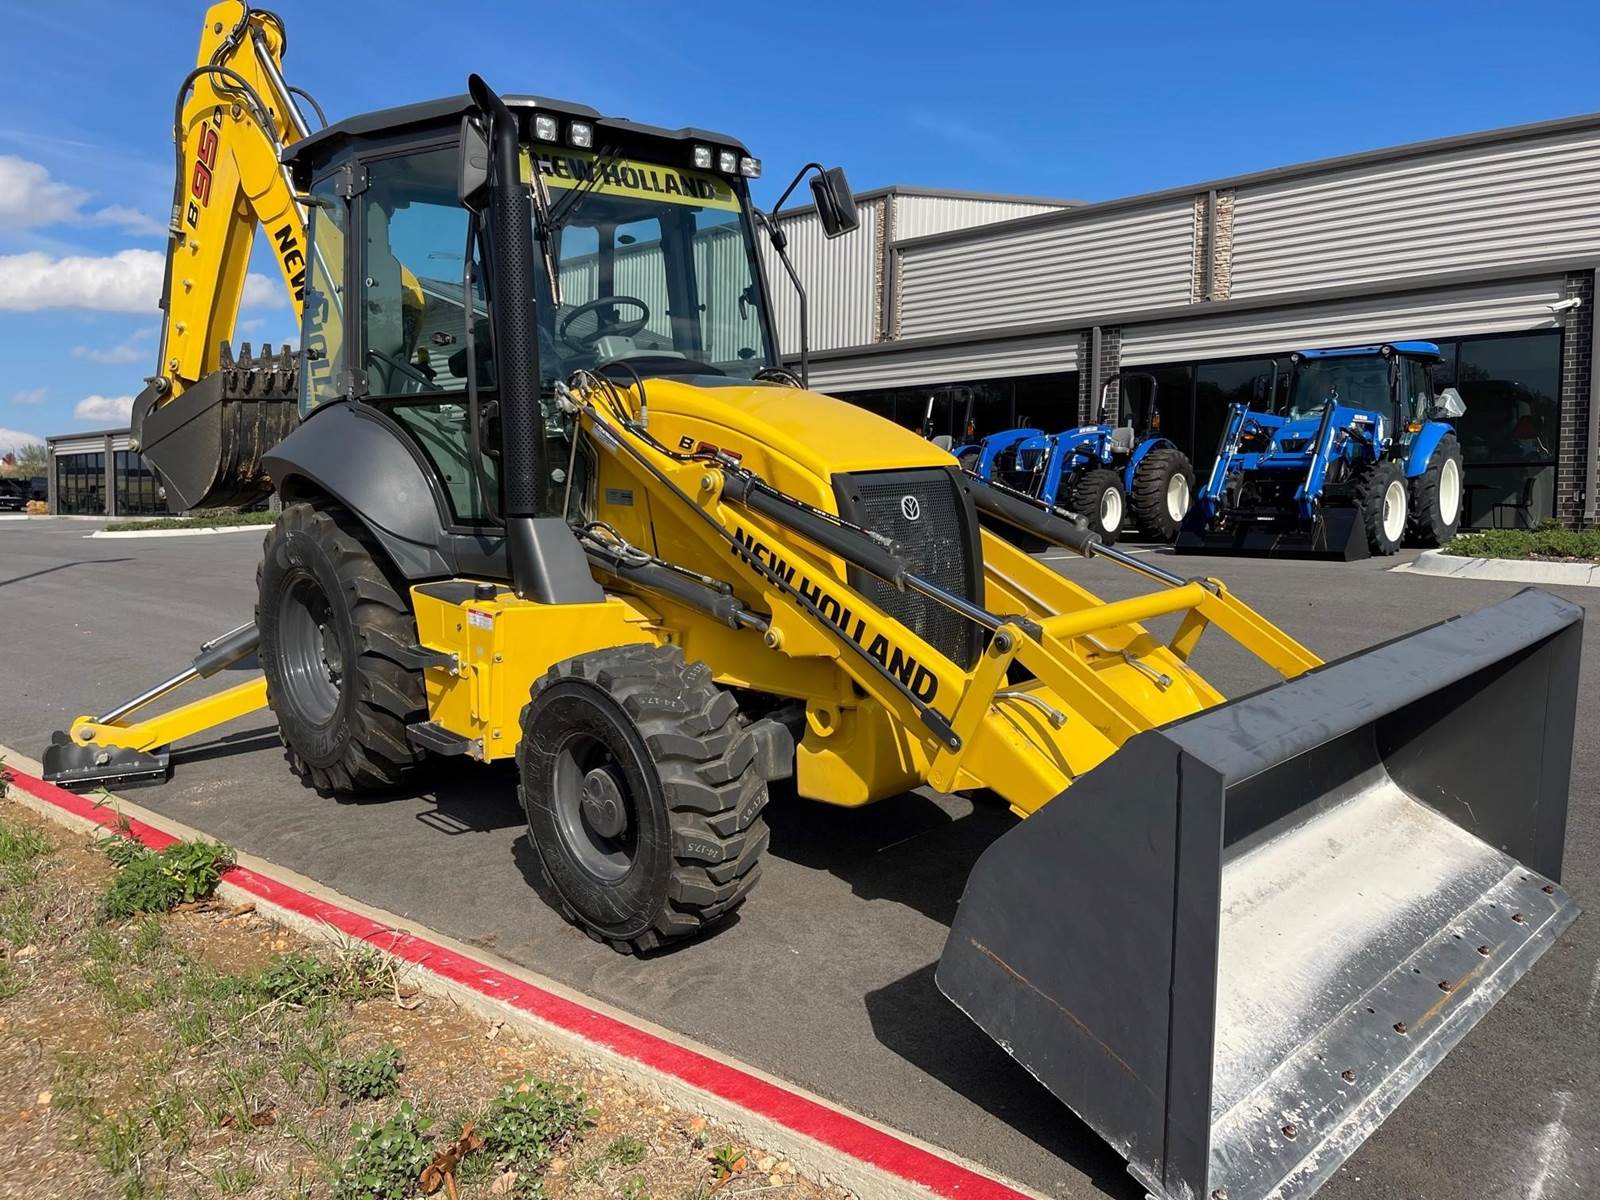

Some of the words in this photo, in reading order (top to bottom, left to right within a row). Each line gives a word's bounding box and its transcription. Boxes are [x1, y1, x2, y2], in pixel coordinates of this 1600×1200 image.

[601, 160, 717, 200] HOLLAND
[731, 527, 796, 594] NEW
[797, 576, 939, 706] HOLLAND
